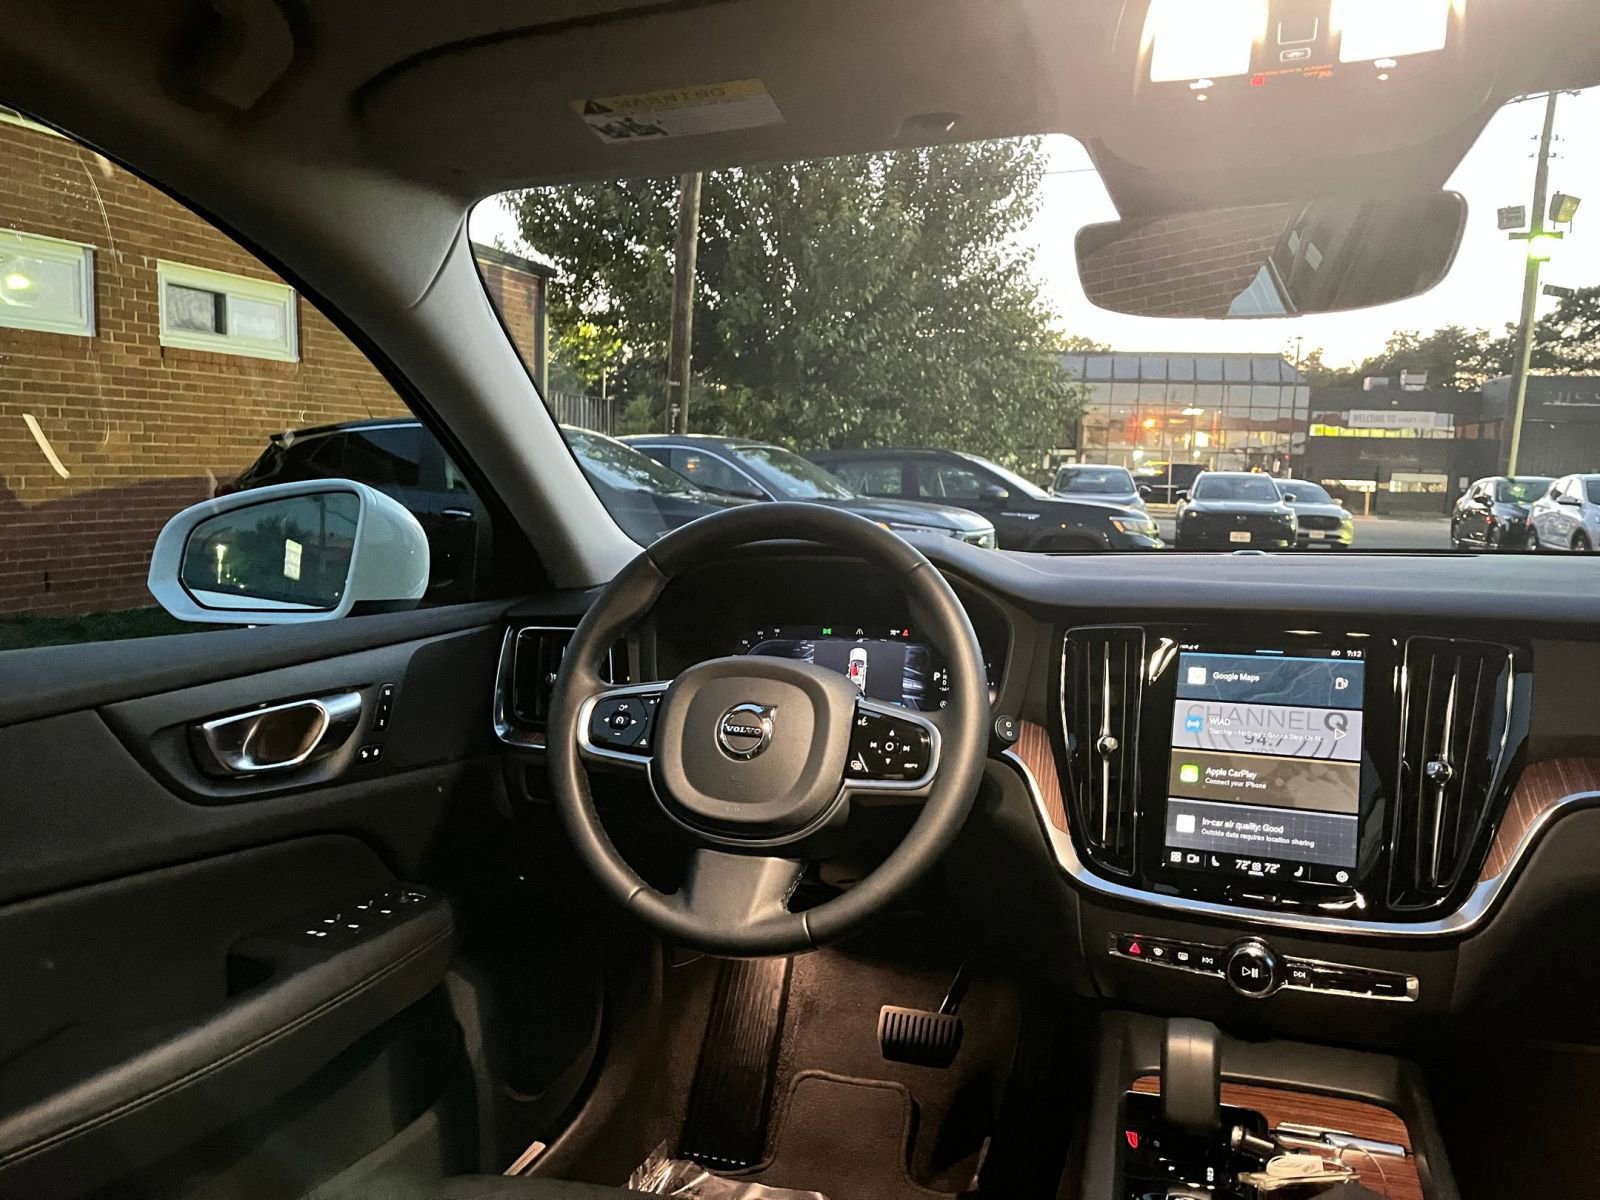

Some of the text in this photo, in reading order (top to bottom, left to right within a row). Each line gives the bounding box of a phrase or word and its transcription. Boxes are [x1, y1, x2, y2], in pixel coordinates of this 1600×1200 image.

[1346, 650, 1362, 658] 7:12
[1213, 671, 1260, 684] Google Maps
[1209, 717, 1231, 726] WIAD
[1323, 711, 1349, 733] Q
[725, 724, 762, 735] VOLVO
[1205, 767, 1258, 780] Apple CarPlay
[1204, 778, 1230, 786] Connect
[1230, 780, 1245, 788] your
[1202, 817, 1224, 827] In-car
[1224, 820, 1235, 828] air
[1262, 824, 1285, 834] Good
[1201, 828, 1315, 849] Outside data requires location sharing
